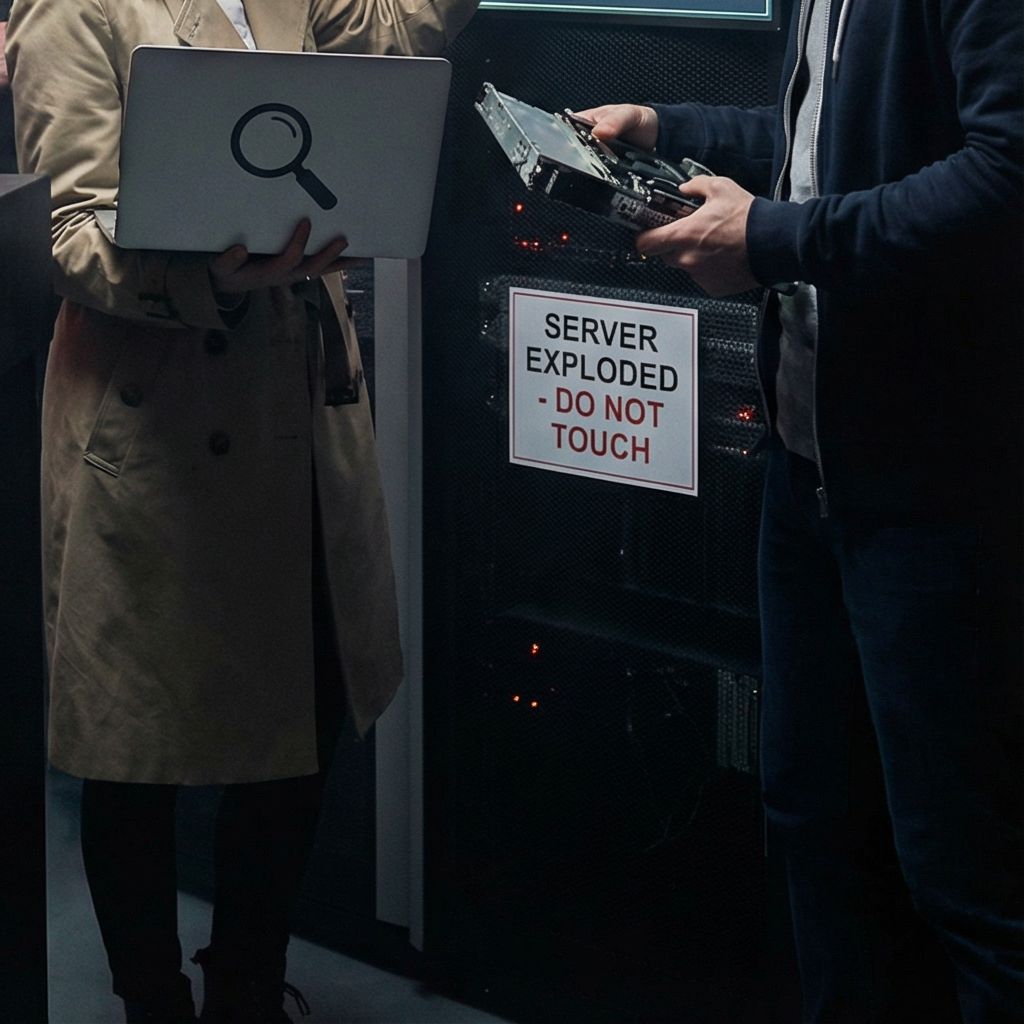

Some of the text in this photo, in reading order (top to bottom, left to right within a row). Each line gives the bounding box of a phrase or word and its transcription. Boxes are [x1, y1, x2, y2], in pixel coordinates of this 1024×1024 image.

[544, 312, 659, 353] SERVER
[526, 346, 678, 392] EXPLODED
[556, 387, 595, 418] DO
[605, 394, 665, 428] NOT
[551, 422, 650, 465] TOUCH
